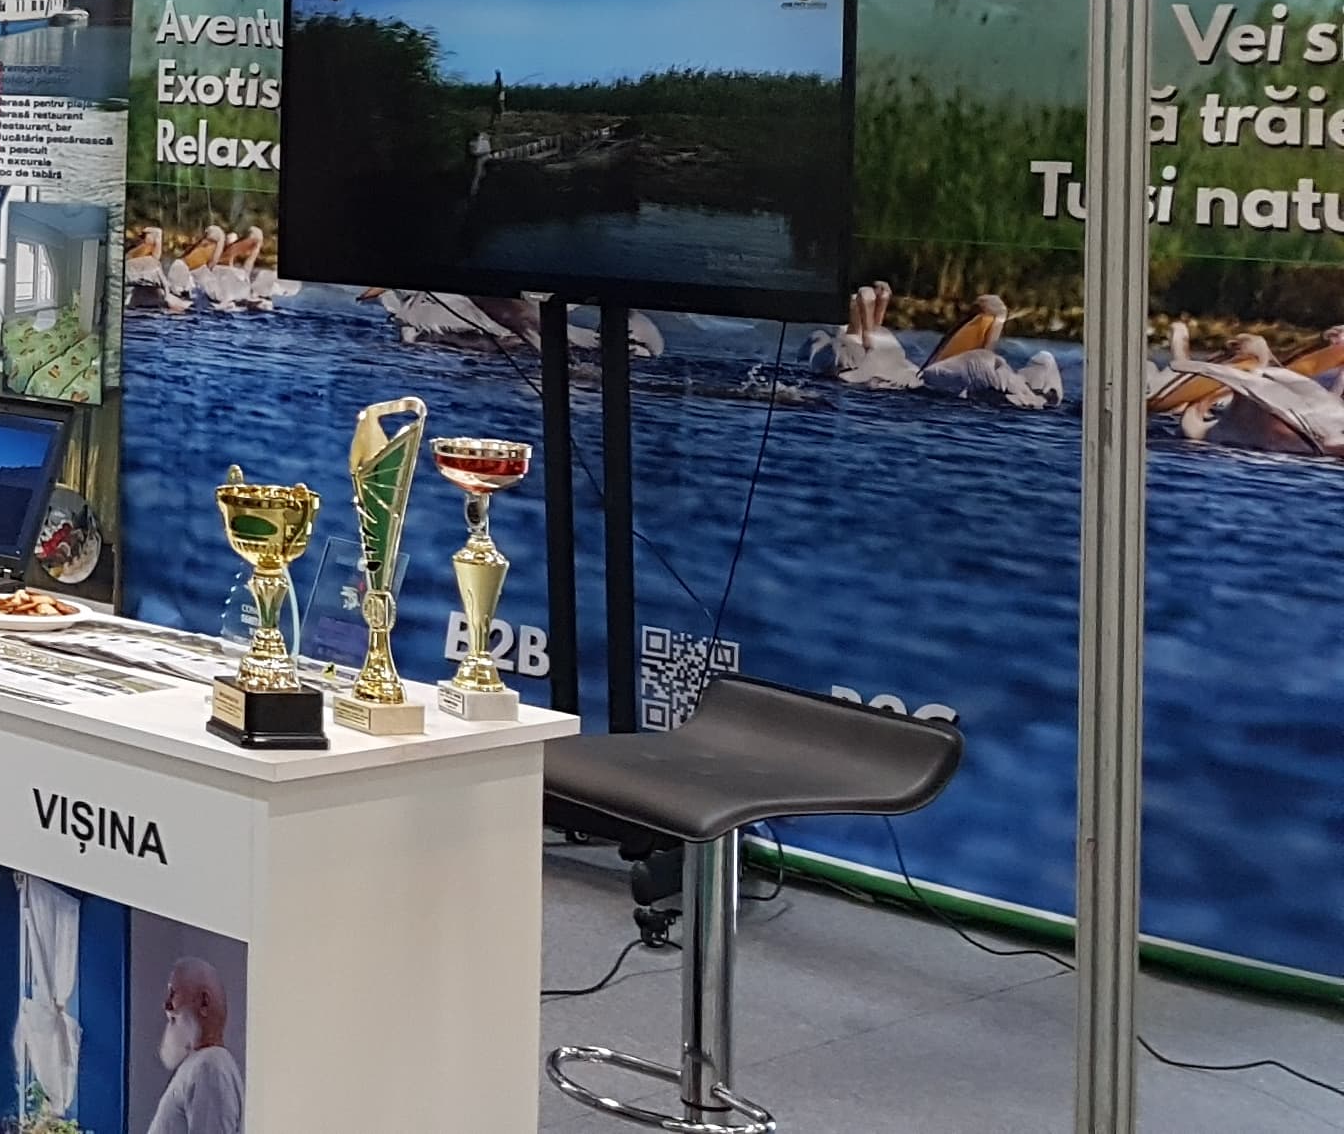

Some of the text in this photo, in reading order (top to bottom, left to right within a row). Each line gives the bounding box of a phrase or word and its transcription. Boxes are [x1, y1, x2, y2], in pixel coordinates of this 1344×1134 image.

[1172, 3, 1288, 64] Vei
[157, 58, 281, 109] Exotis
[33, 100, 64, 109] pentru
[33, 112, 83, 120] restaurant
[1148, 84, 1179, 145] ă
[56, 123, 72, 132] bar
[9, 145, 48, 155] pescuit
[15, 168, 29, 177] de
[443, 610, 551, 678] B2B
[32, 787, 168, 866] VIȘINA
